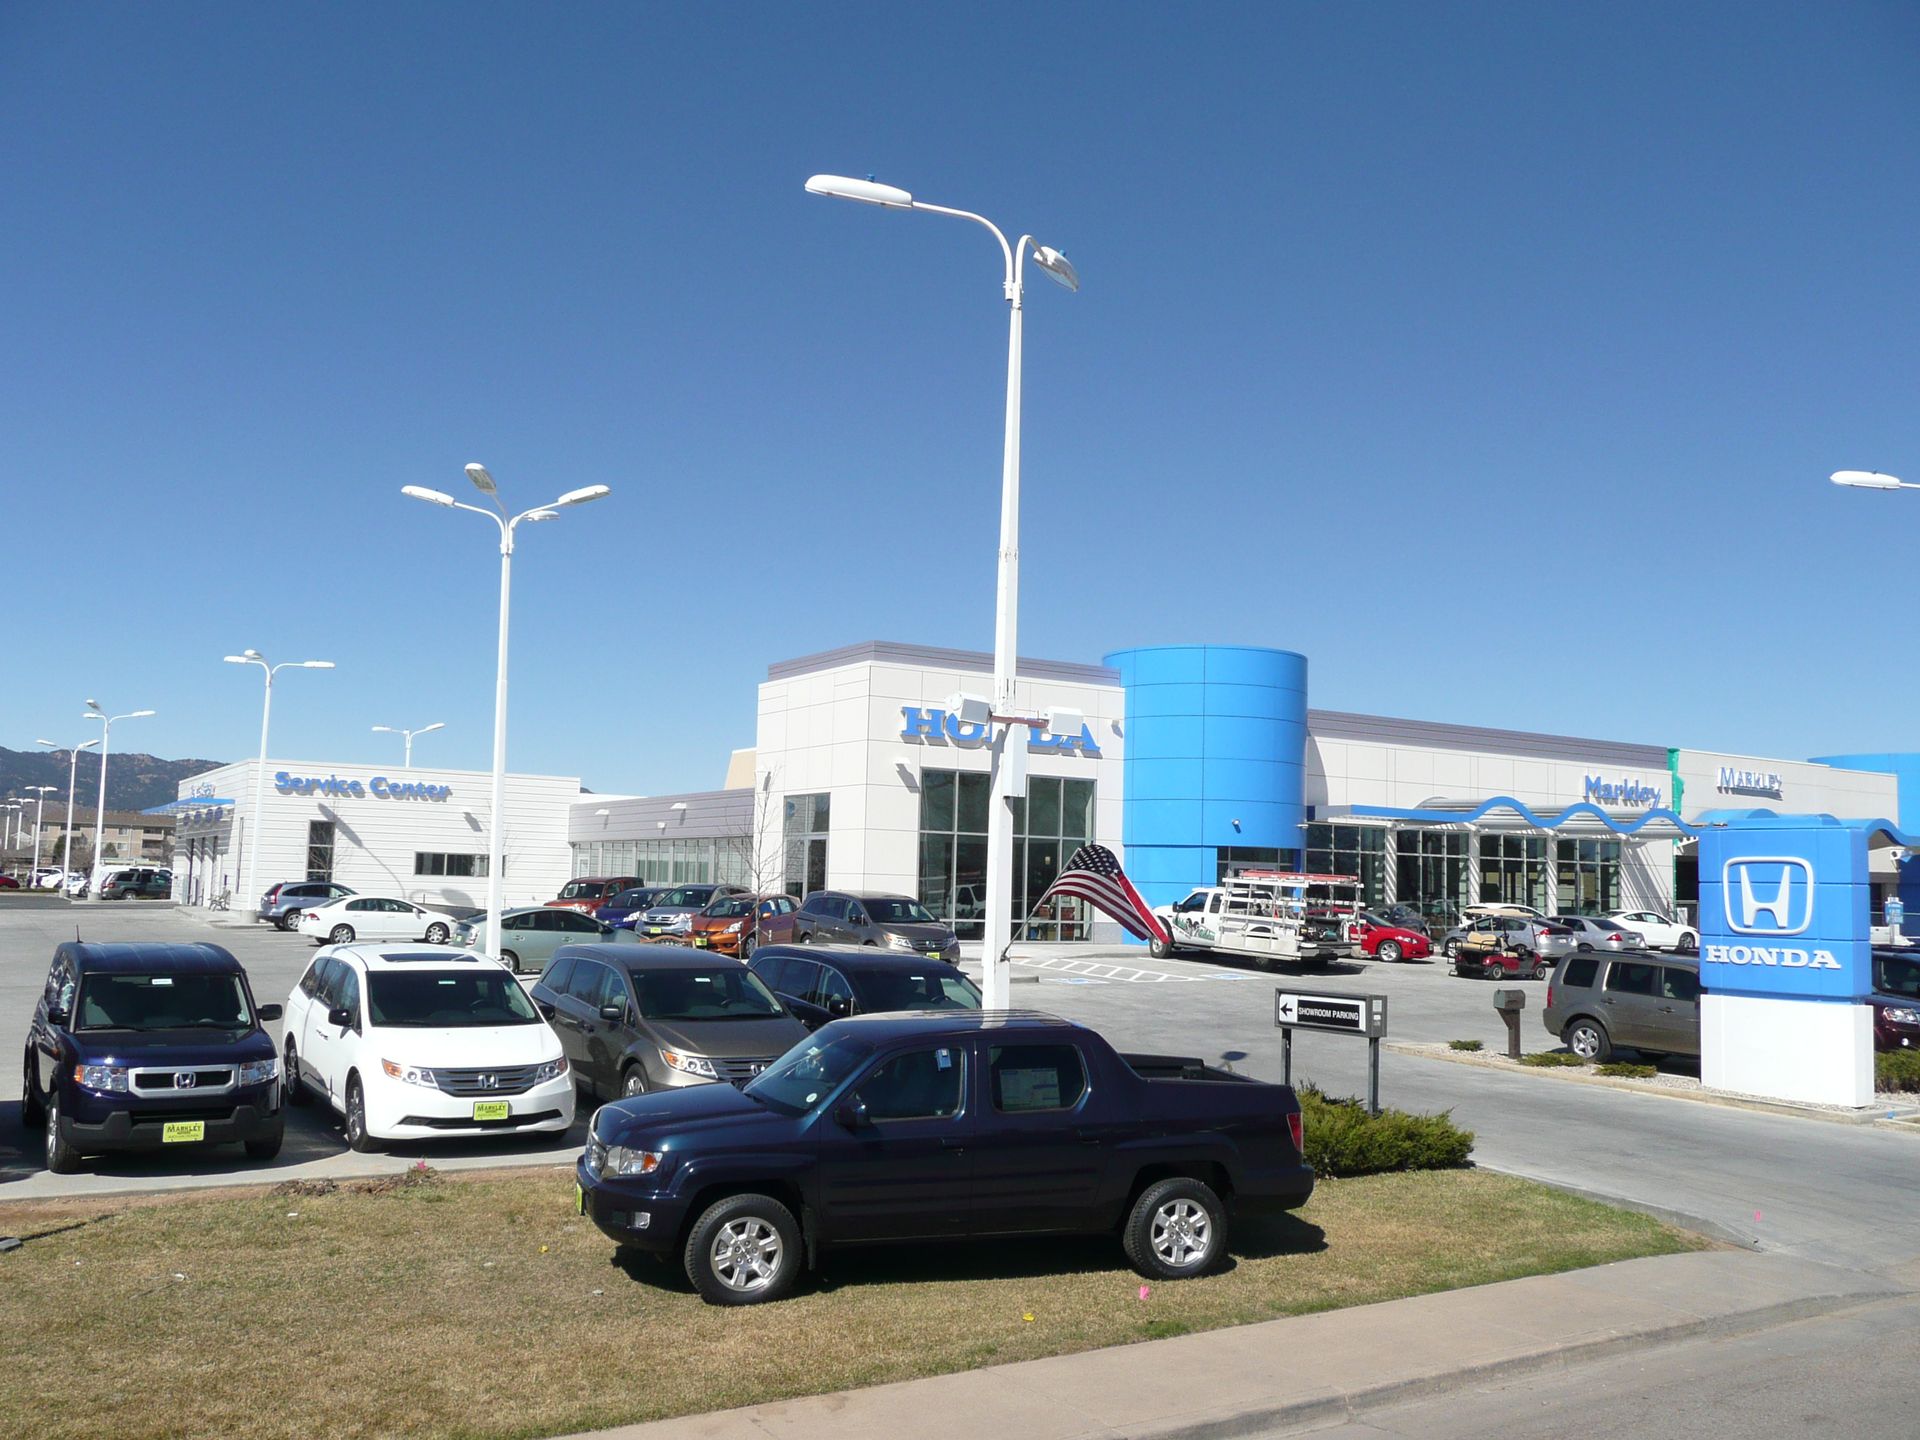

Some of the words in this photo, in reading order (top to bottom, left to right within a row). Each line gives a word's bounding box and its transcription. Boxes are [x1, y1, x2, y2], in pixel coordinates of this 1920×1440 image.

[274, 771, 363, 796] Service
[369, 775, 452, 799] Center
[1584, 774, 1662, 809] Markley
[1719, 766, 1783, 791] MARKLEY
[1705, 944, 1842, 970] HONDA
[1298, 1006, 1332, 1018] SHOWROOM
[1332, 1010, 1359, 1021] PARKING
